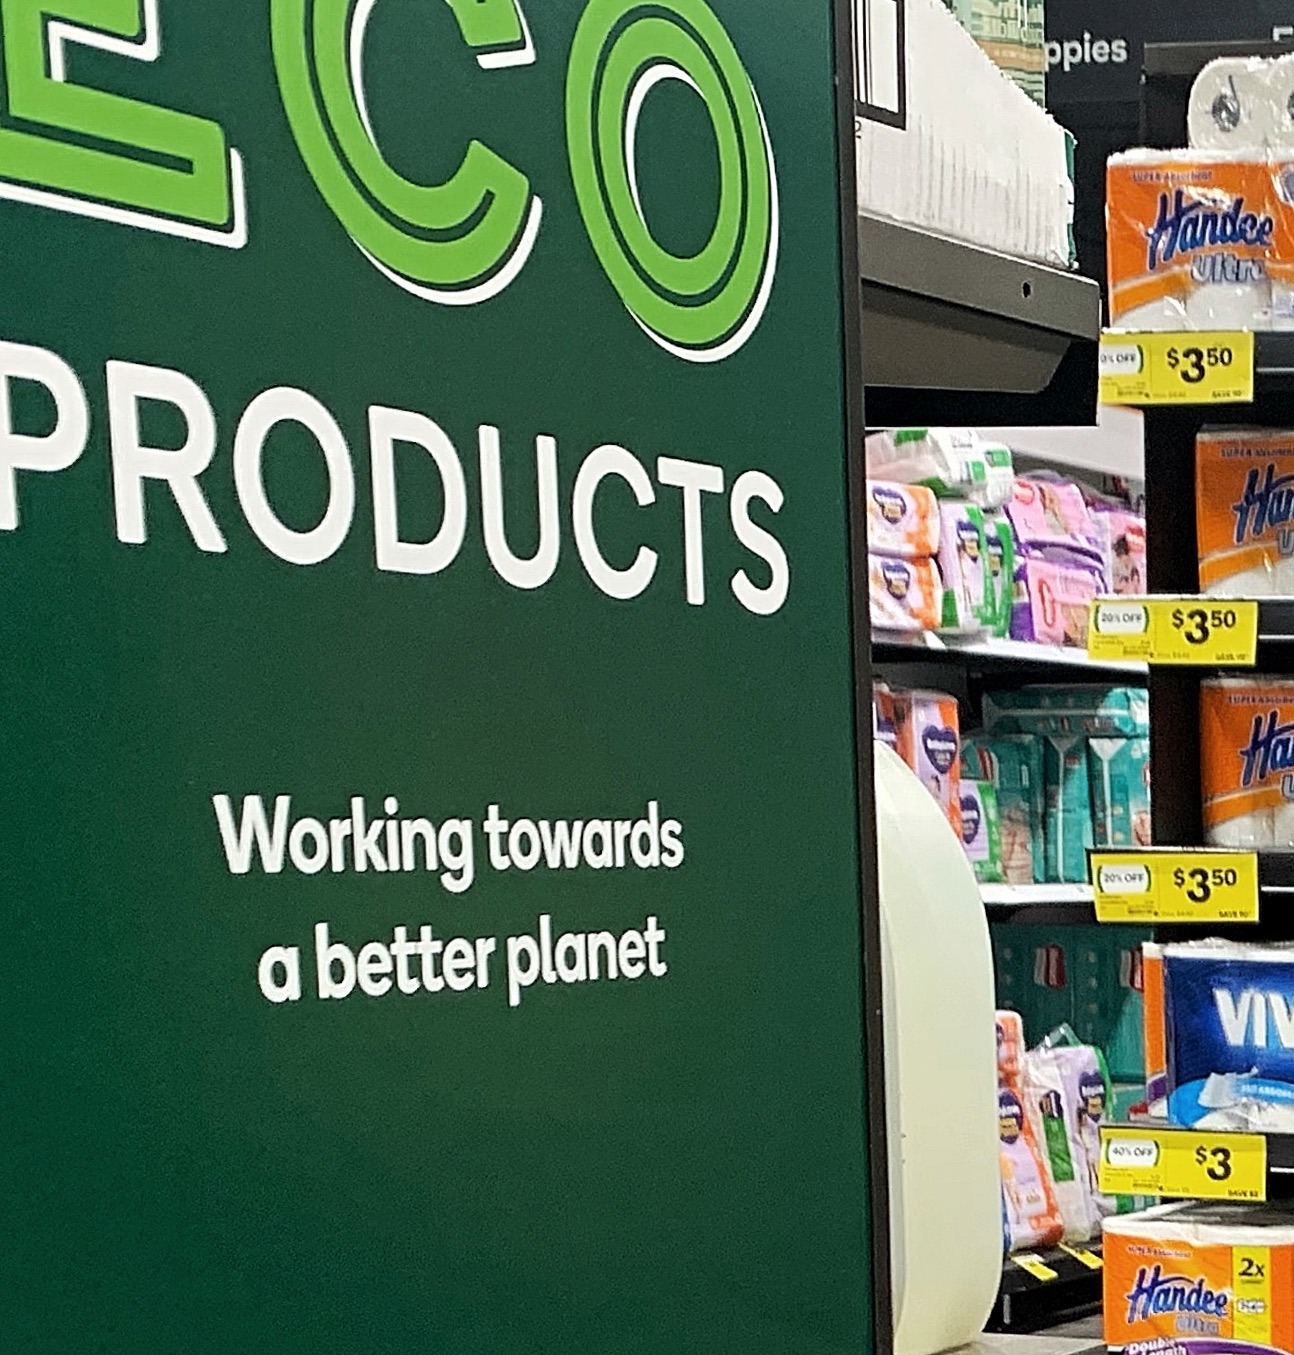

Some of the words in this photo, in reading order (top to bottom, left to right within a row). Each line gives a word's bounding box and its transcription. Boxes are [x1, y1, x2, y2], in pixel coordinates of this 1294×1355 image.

[0, 0, 778, 362] ECO
[1147, 190, 1274, 271] Handee
[0, 340, 790, 615] PRODUCTS
[212, 794, 474, 894] Working
[484, 801, 686, 873] towards
[257, 941, 302, 1004] a
[315, 921, 497, 1000] better
[507, 914, 669, 1008] planet
[1195, 1145, 1232, 1181] $3
[1127, 1264, 1229, 1324] Handee
[1238, 1257, 1266, 1278] 2x
[1126, 1338, 1177, 1355] Double
